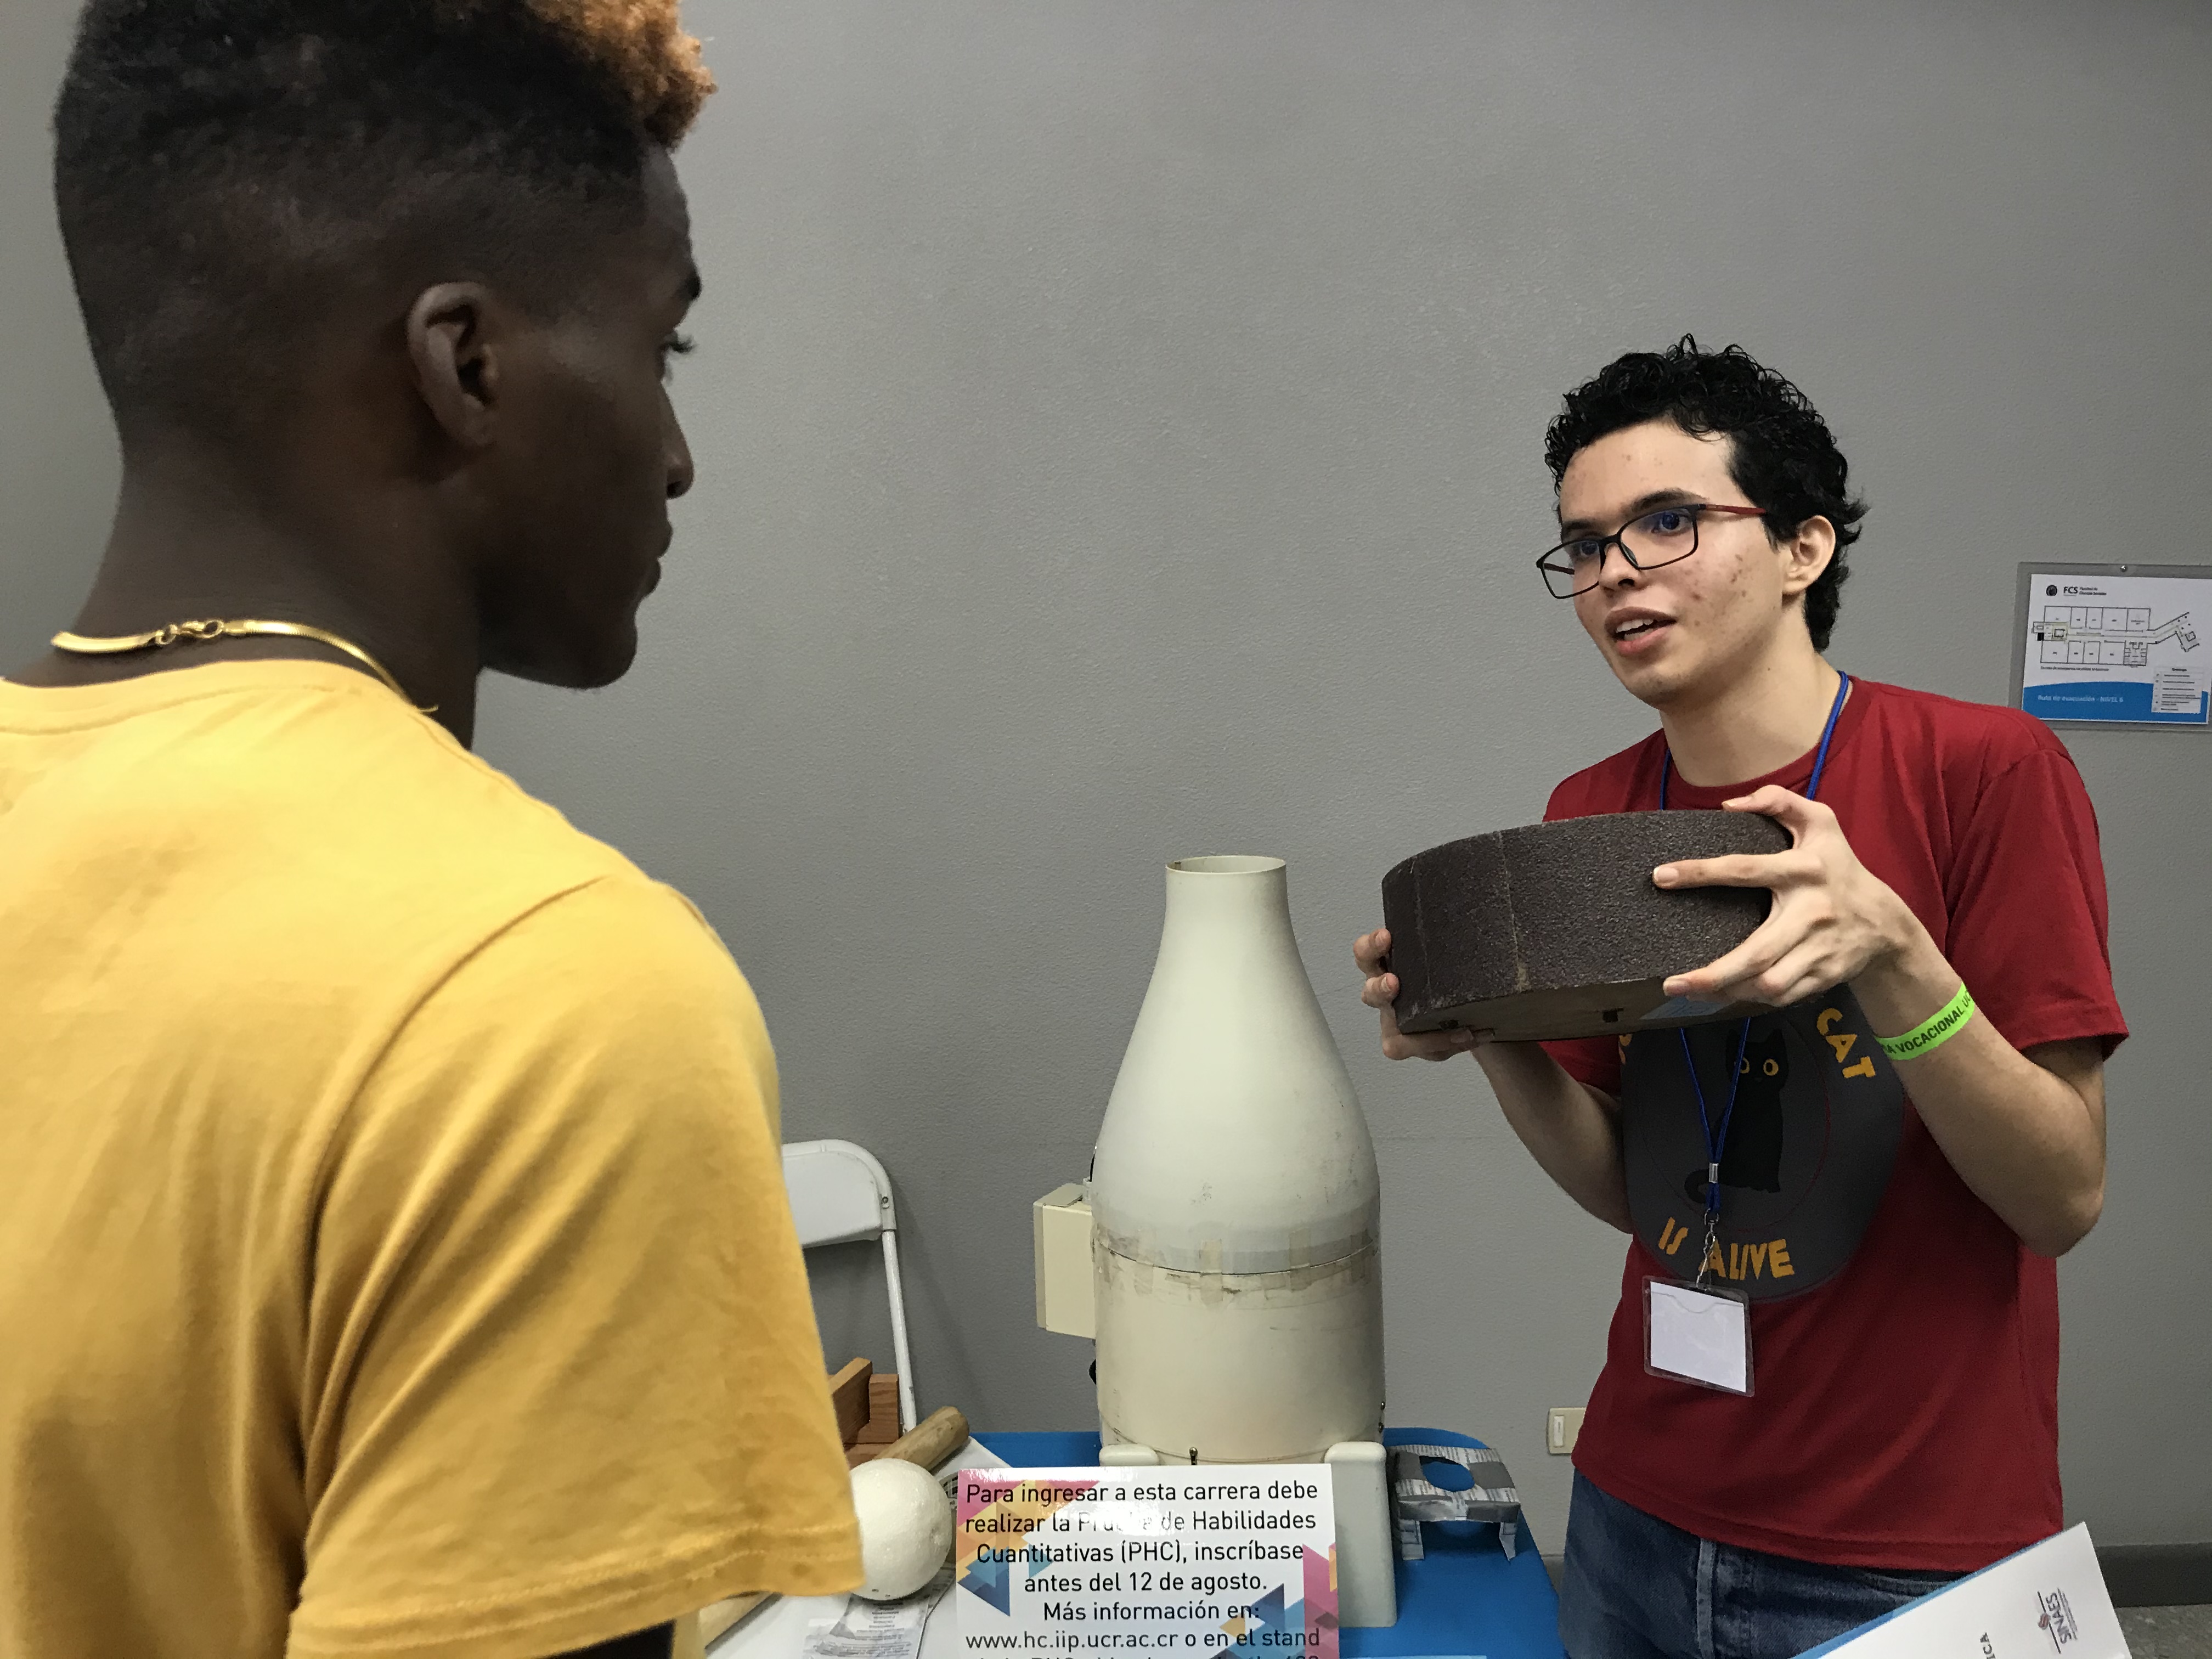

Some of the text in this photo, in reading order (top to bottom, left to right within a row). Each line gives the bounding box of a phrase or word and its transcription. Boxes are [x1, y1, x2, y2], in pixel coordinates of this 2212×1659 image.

[1895, 1006, 1965, 1052] VOCACIONAL
[1816, 1007, 1876, 1079] CAT
[1658, 1217, 1795, 1276] IS ALIVE
[967, 1483, 1014, 1503] Para
[1022, 1483, 1109, 1507] ingresar
[1115, 1487, 1126, 1501] a
[1133, 1483, 1176, 1501] esta
[1184, 1485, 1260, 1500] carrera
[1267, 1480, 1318, 1499] debe
[966, 1513, 1044, 1533] realizar
[1053, 1512, 1070, 1532] la
[1161, 1511, 1185, 1531] de
[1193, 1510, 1316, 1531] Habilidades
[977, 1539, 1304, 1564] Cuantitativas (PHC), inscríbase
[1024, 1572, 1267, 1596] antes del 12 de agosto.
[1044, 1600, 1260, 1621] Más información en:
[965, 1627, 1320, 1652] www.hc.iip.ucr.ac.cr o en el stand
